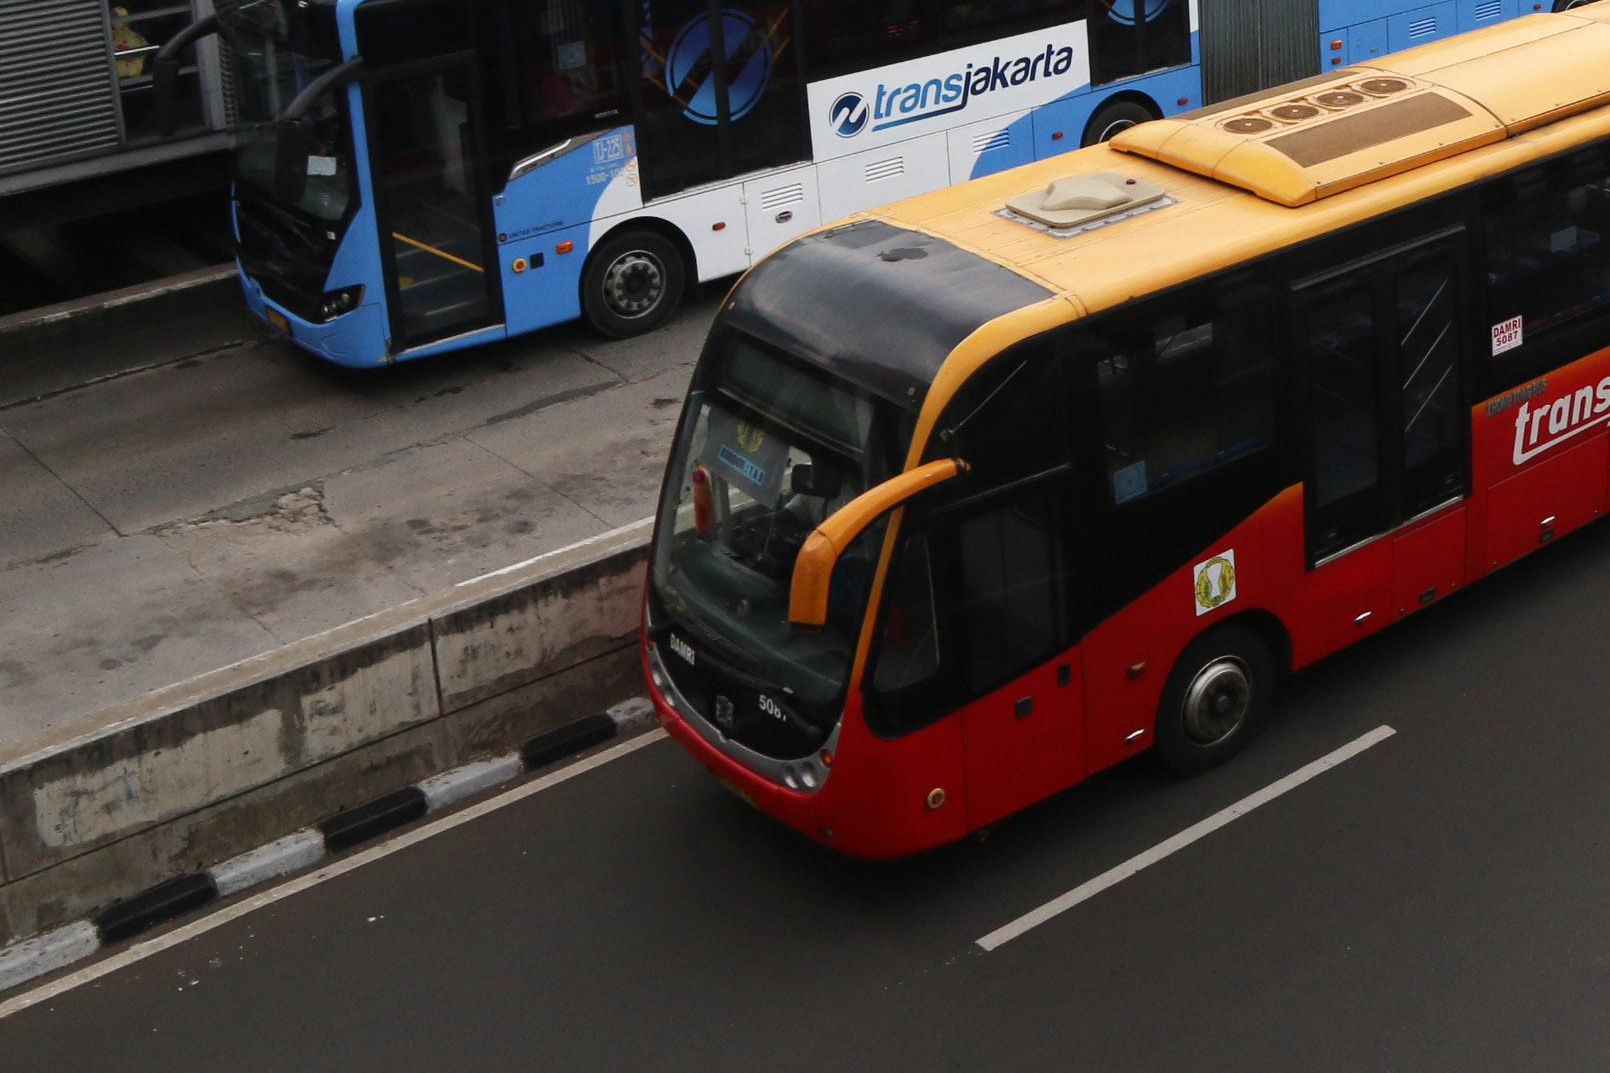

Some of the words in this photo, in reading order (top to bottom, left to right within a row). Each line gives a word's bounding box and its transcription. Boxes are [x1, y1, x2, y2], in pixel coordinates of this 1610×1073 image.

[872, 43, 1074, 131] transjakarta
[1493, 317, 1521, 339] DAMRI
[1496, 330, 1519, 347] 5087
[670, 632, 695, 666] DAMRI
[759, 693, 787, 722] 508
